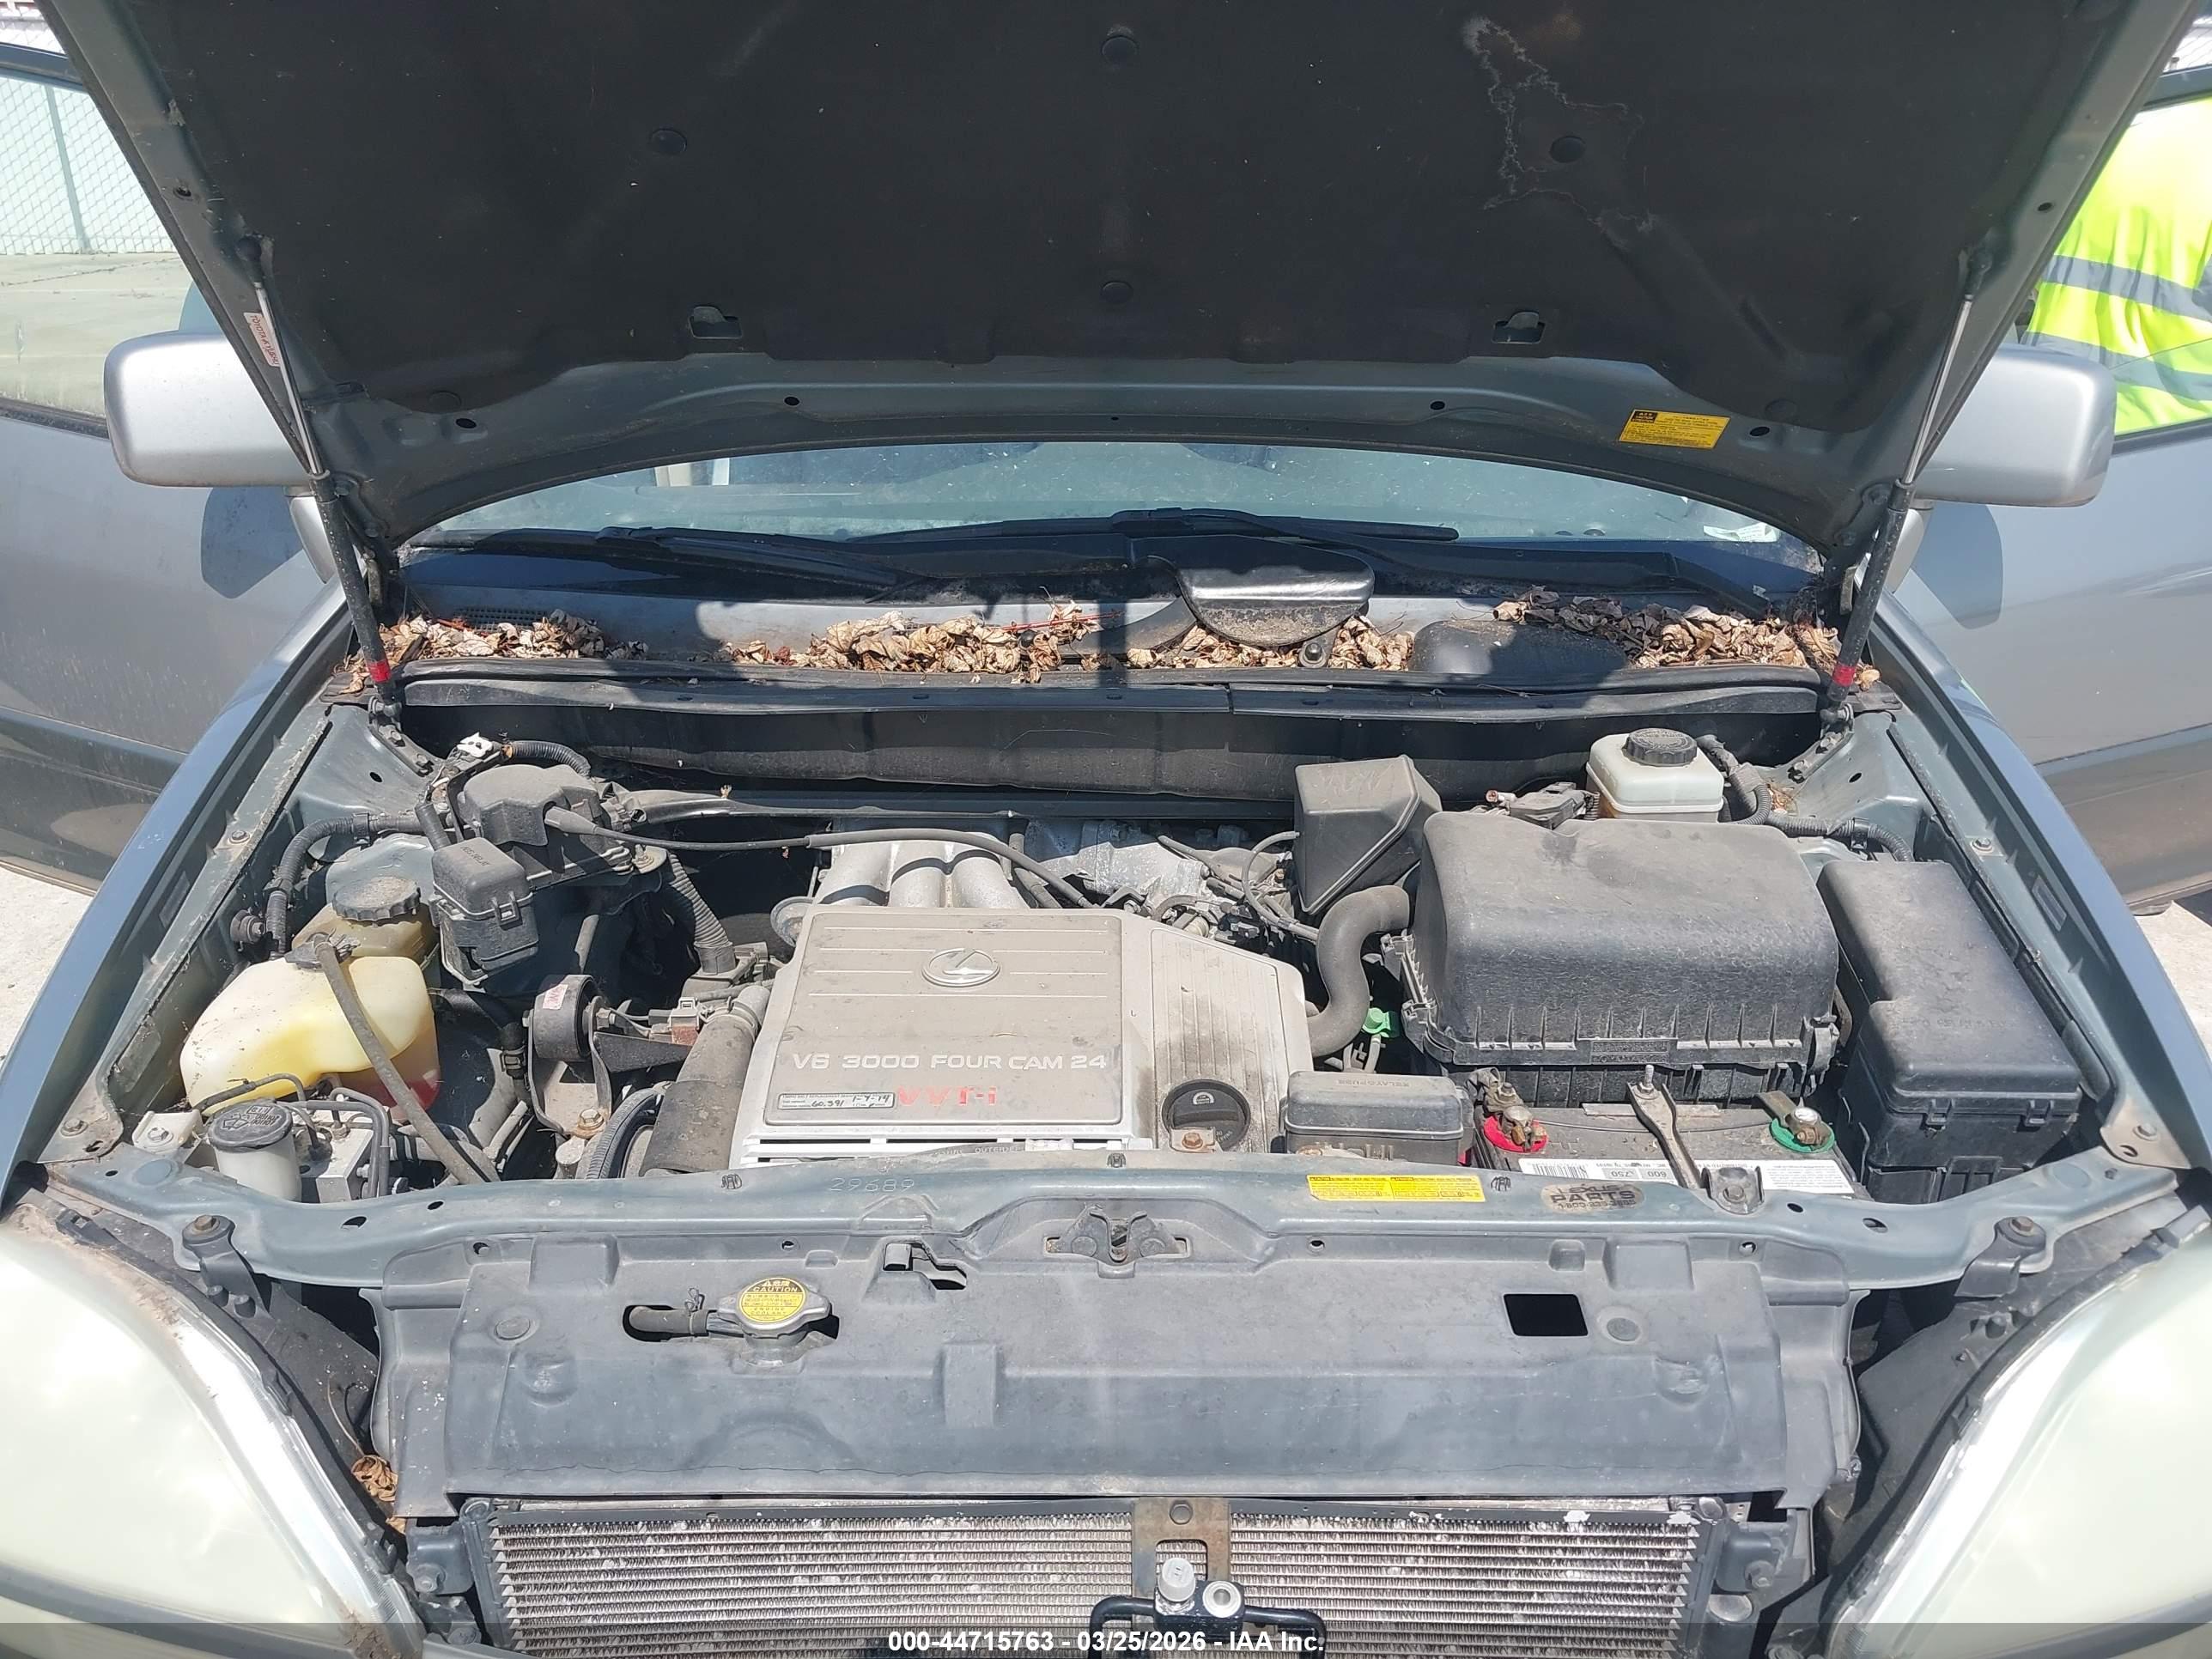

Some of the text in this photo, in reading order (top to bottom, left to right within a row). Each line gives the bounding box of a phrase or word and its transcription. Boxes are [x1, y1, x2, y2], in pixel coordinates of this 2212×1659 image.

[793, 1054, 1108, 1070] V6 3000 FOUR CAM 24
[829, 1176, 915, 1193] 29689
[1557, 1184, 1621, 1195] LEXUS
[1549, 1190, 1636, 1203] PARTS
